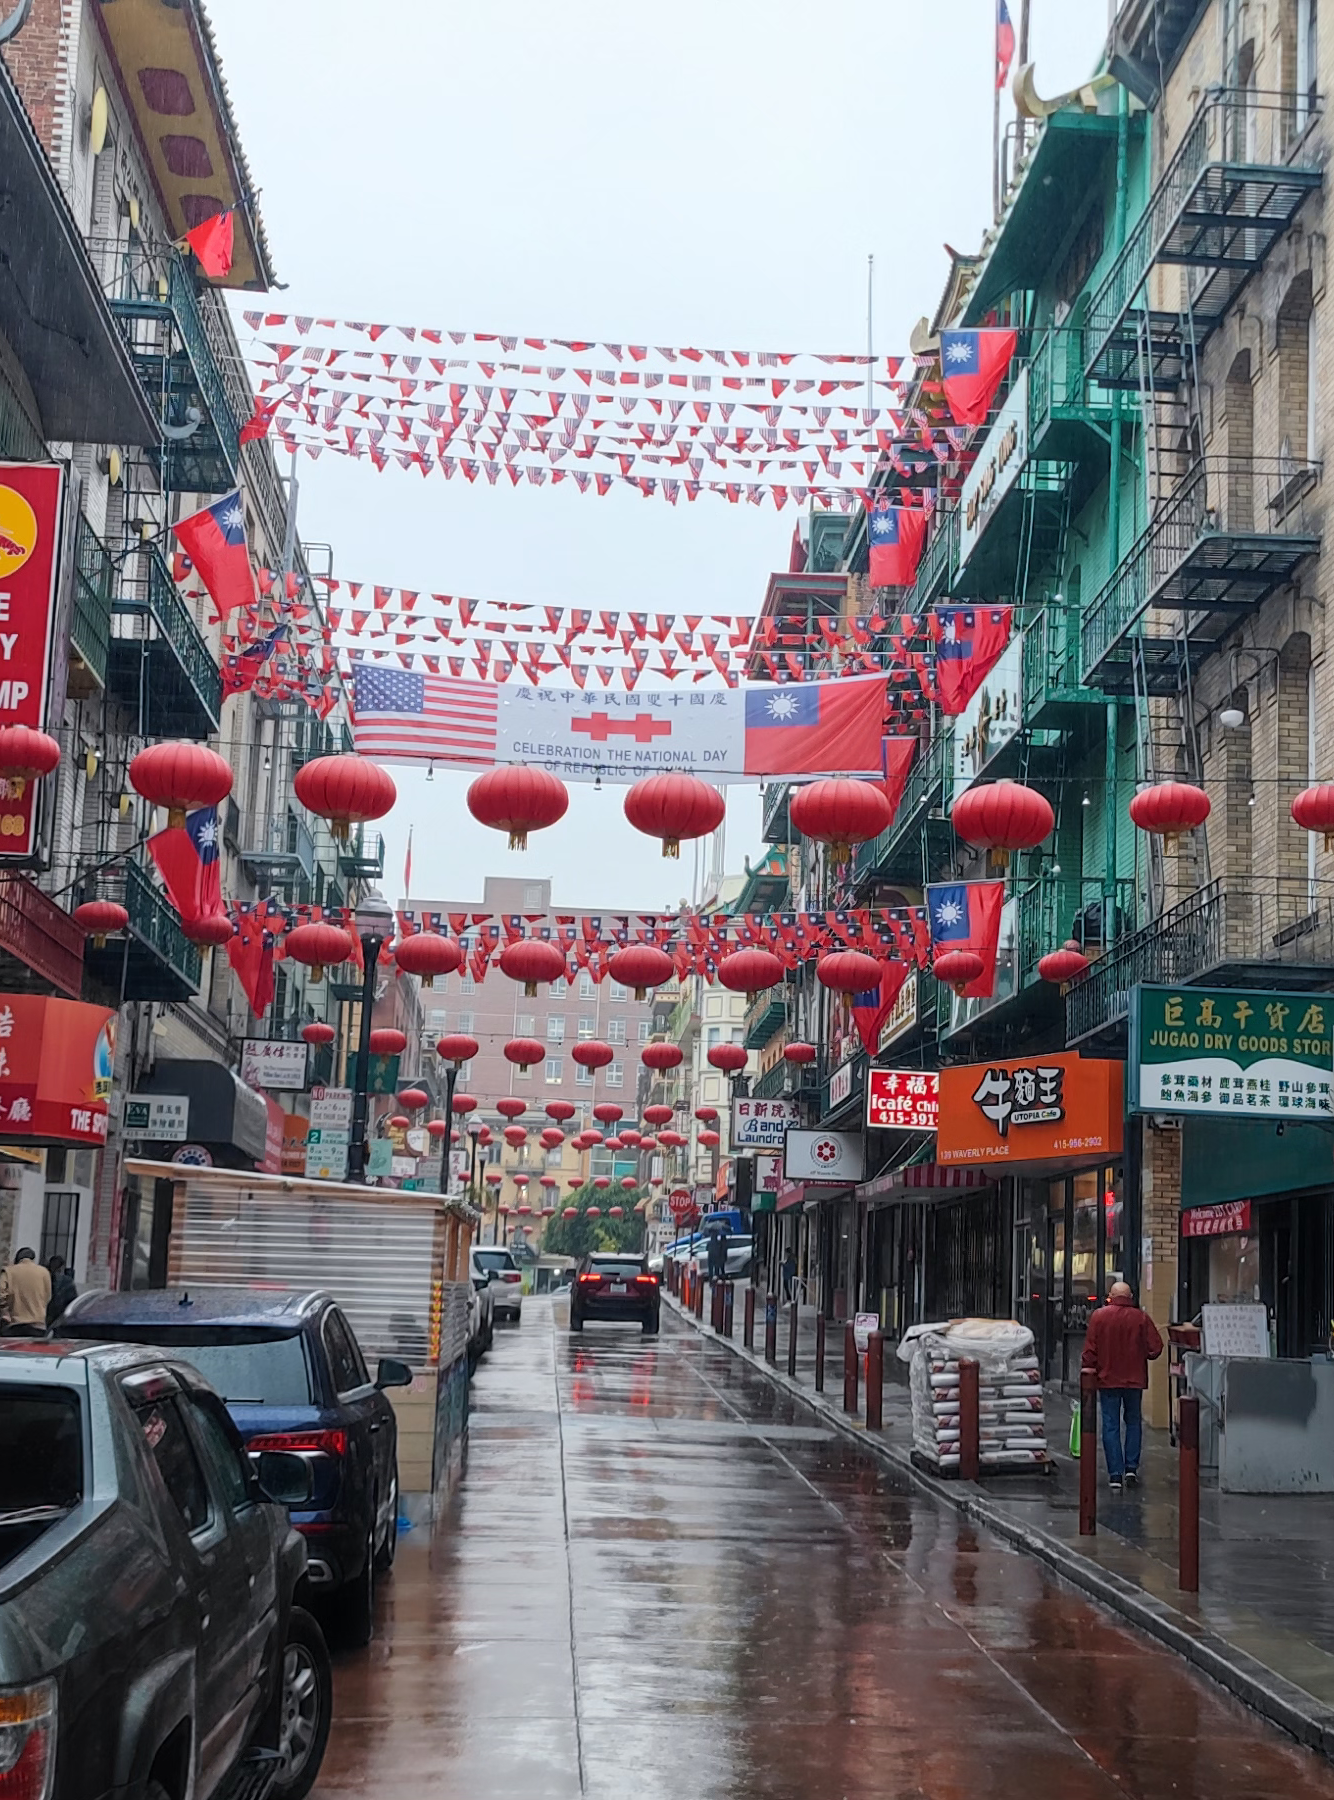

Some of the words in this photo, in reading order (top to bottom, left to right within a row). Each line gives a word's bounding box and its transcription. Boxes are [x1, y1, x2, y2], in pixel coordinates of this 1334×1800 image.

[513, 741, 601, 760] CELEBRATION
[607, 749, 632, 762] THE
[635, 750, 697, 762] NATIONAL
[703, 749, 728, 762] DAY
[544, 761, 561, 773] OF
[564, 762, 627, 777] REPUBLIC
[633, 765, 650, 777] OF
[1149, 1030, 1199, 1048] JUGAO
[1204, 1033, 1232, 1050] DRY
[1238, 1036, 1288, 1054] GOODS
[1293, 1038, 1332, 1056] STOR
[313, 1088, 324, 1100] NO
[325, 1092, 350, 1100] PARKING
[71, 1108, 91, 1132] THE
[879, 1111, 938, 1126] 415-391-
[1014, 1112, 1040, 1121] UTOPIA
[760, 1119, 784, 1132] and
[310, 1131, 319, 1142] 2
[738, 1133, 784, 1145] Laundro
[952, 1147, 985, 1158] WAVERLY
[986, 1145, 1009, 1156] PLACE
[670, 1196, 691, 1207] STOP
